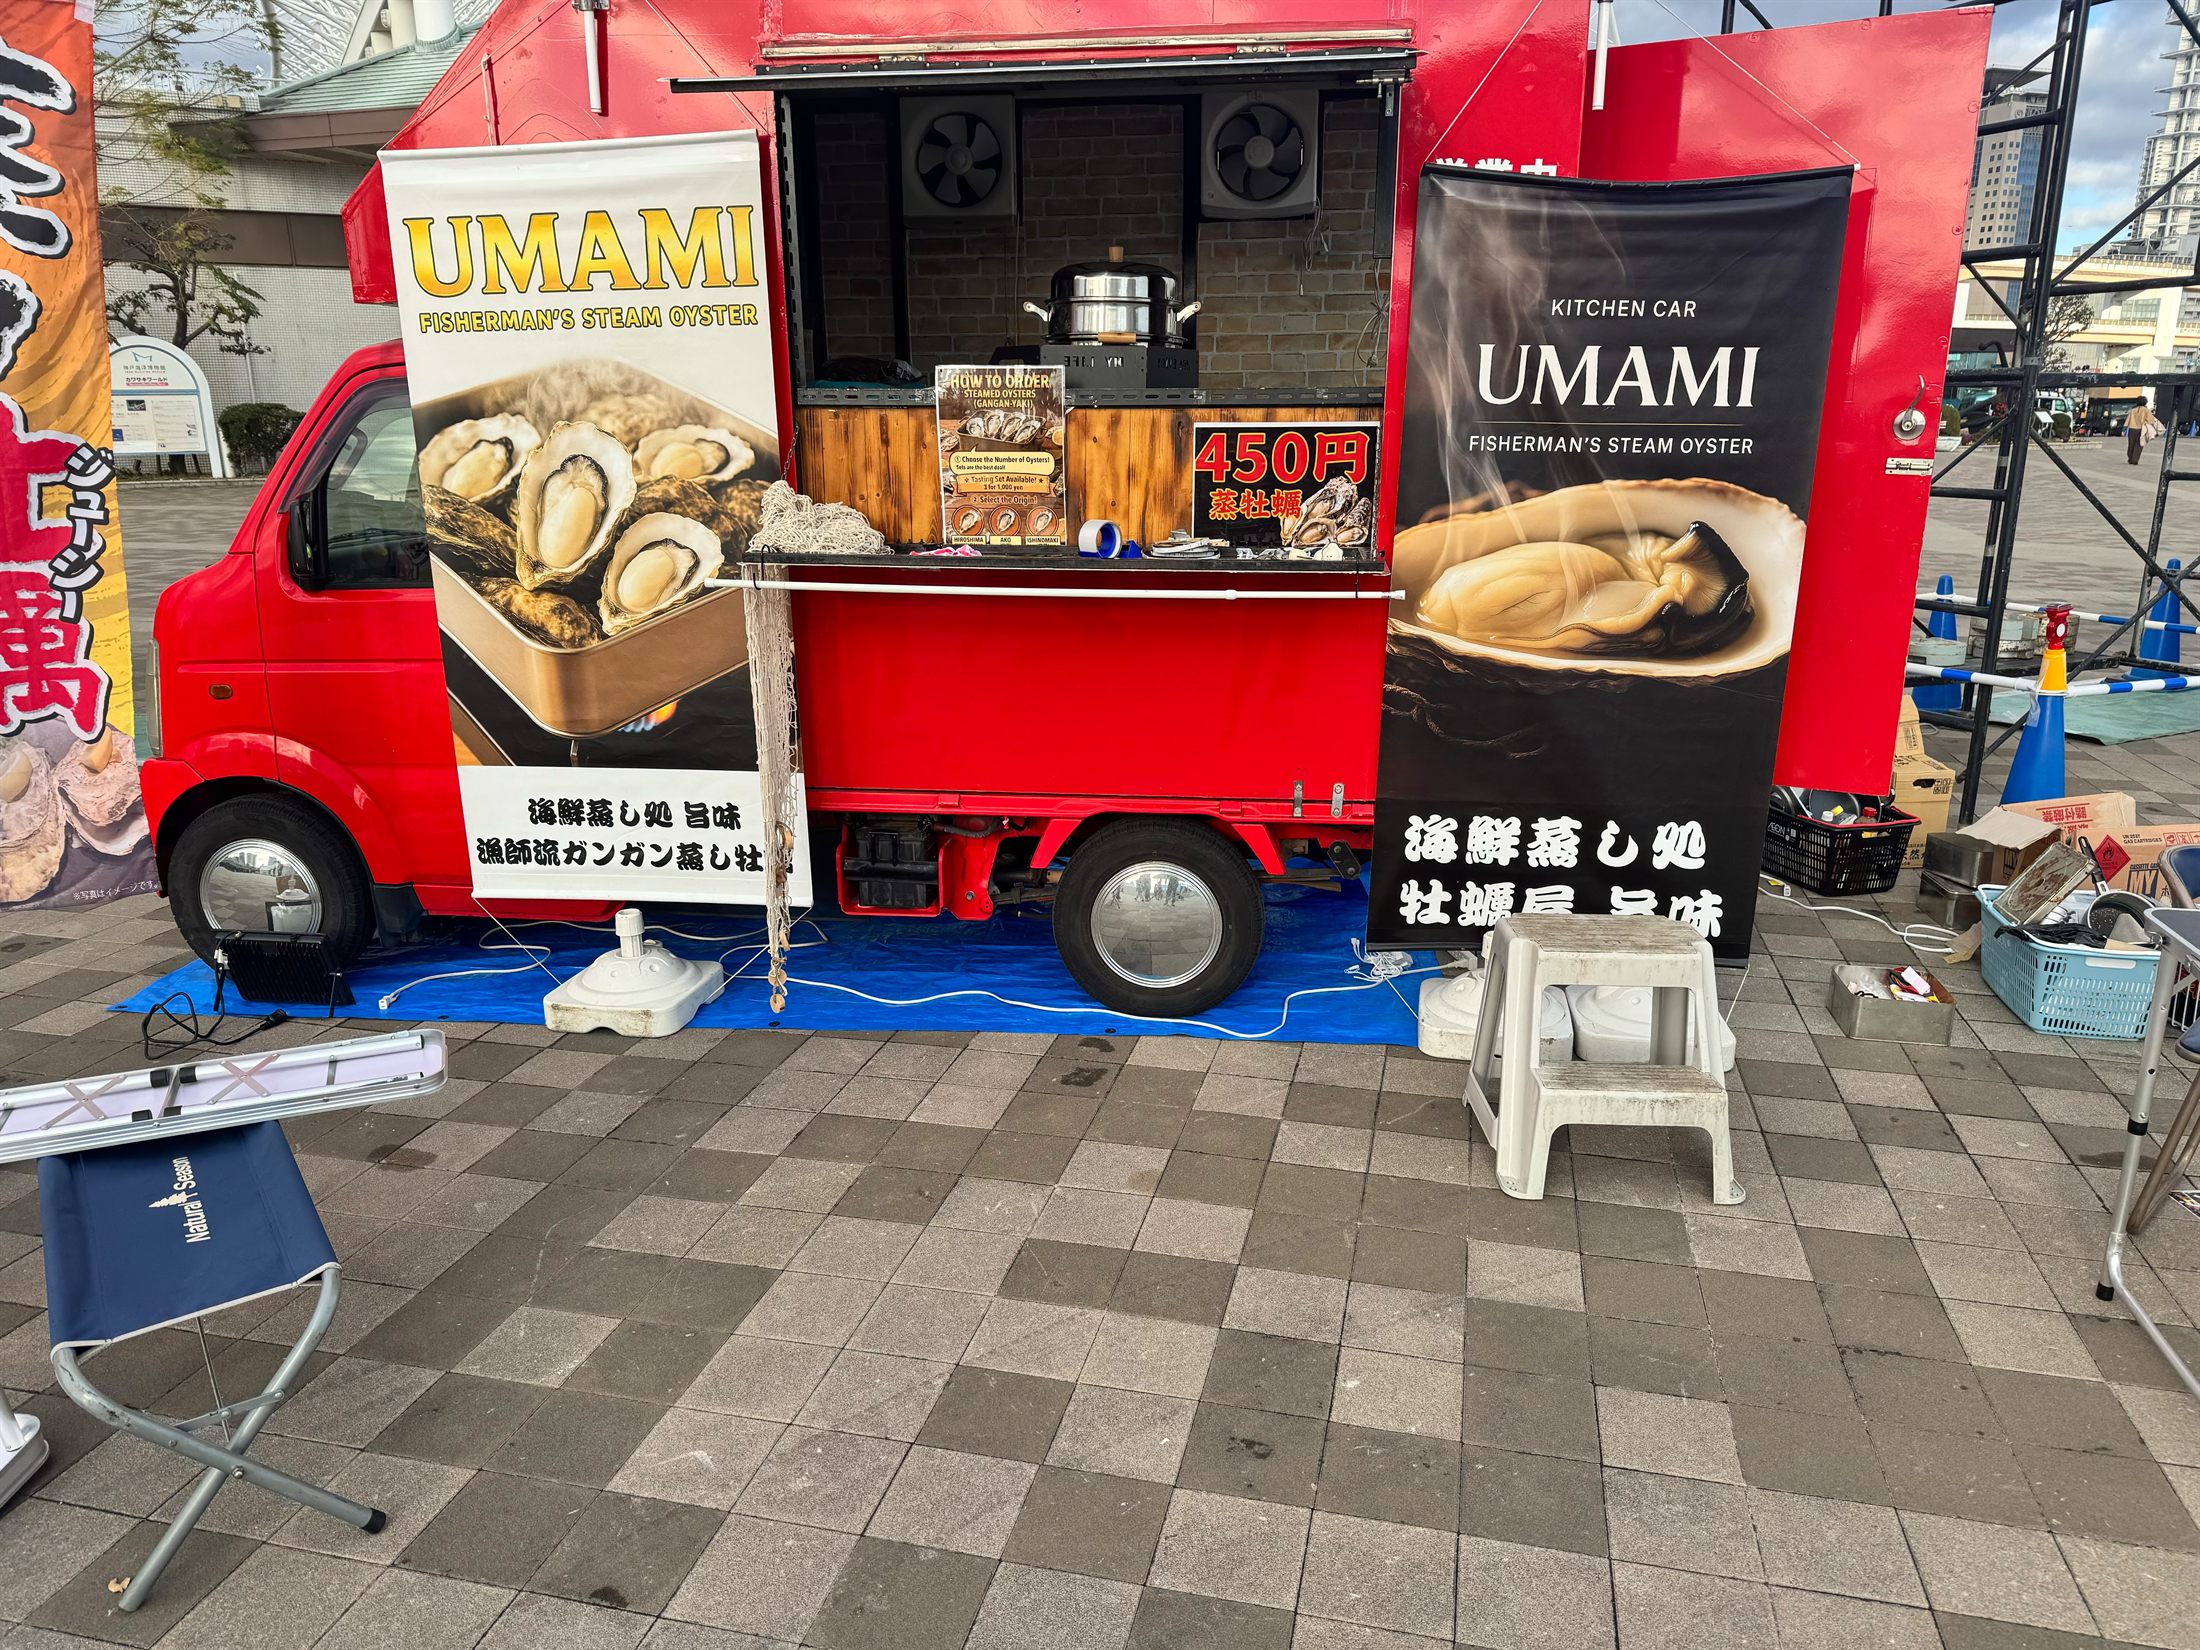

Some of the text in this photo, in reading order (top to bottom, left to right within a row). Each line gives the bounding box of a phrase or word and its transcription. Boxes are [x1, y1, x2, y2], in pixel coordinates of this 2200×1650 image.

[402, 204, 759, 297] UMAMI
[418, 303, 758, 334] FISHERMAN'S STEAM OYSTER
[1551, 299, 1697, 319] KITCHEN CAR
[950, 374, 1050, 389] HOW TO ORDER
[1478, 343, 1760, 408] UMAMI
[964, 389, 1036, 398] STEAMED OYSTERS
[973, 400, 1033, 409] (GANGAN-YAKI)
[1026, 456, 1050, 464] Oysters!
[1195, 431, 1370, 485] 450円
[1469, 435, 1754, 455] FISHERMAN'S STEAM OYSTER
[971, 476, 993, 484] Tasting
[1006, 476, 1037, 484] Available!
[1013, 496, 1037, 505] Origin!
[1209, 488, 1302, 520] 蒸牡蠣
[48, 442, 116, 624] ジューシー
[528, 798, 742, 830] 海鮮蒸し処 旨味
[476, 837, 793, 874] 漁師流ガンガン蒸し牡
[1404, 814, 1707, 871] 海鮮蒸し処
[2128, 870, 2158, 898] MY
[172, 1156, 211, 1243] Natural Season
